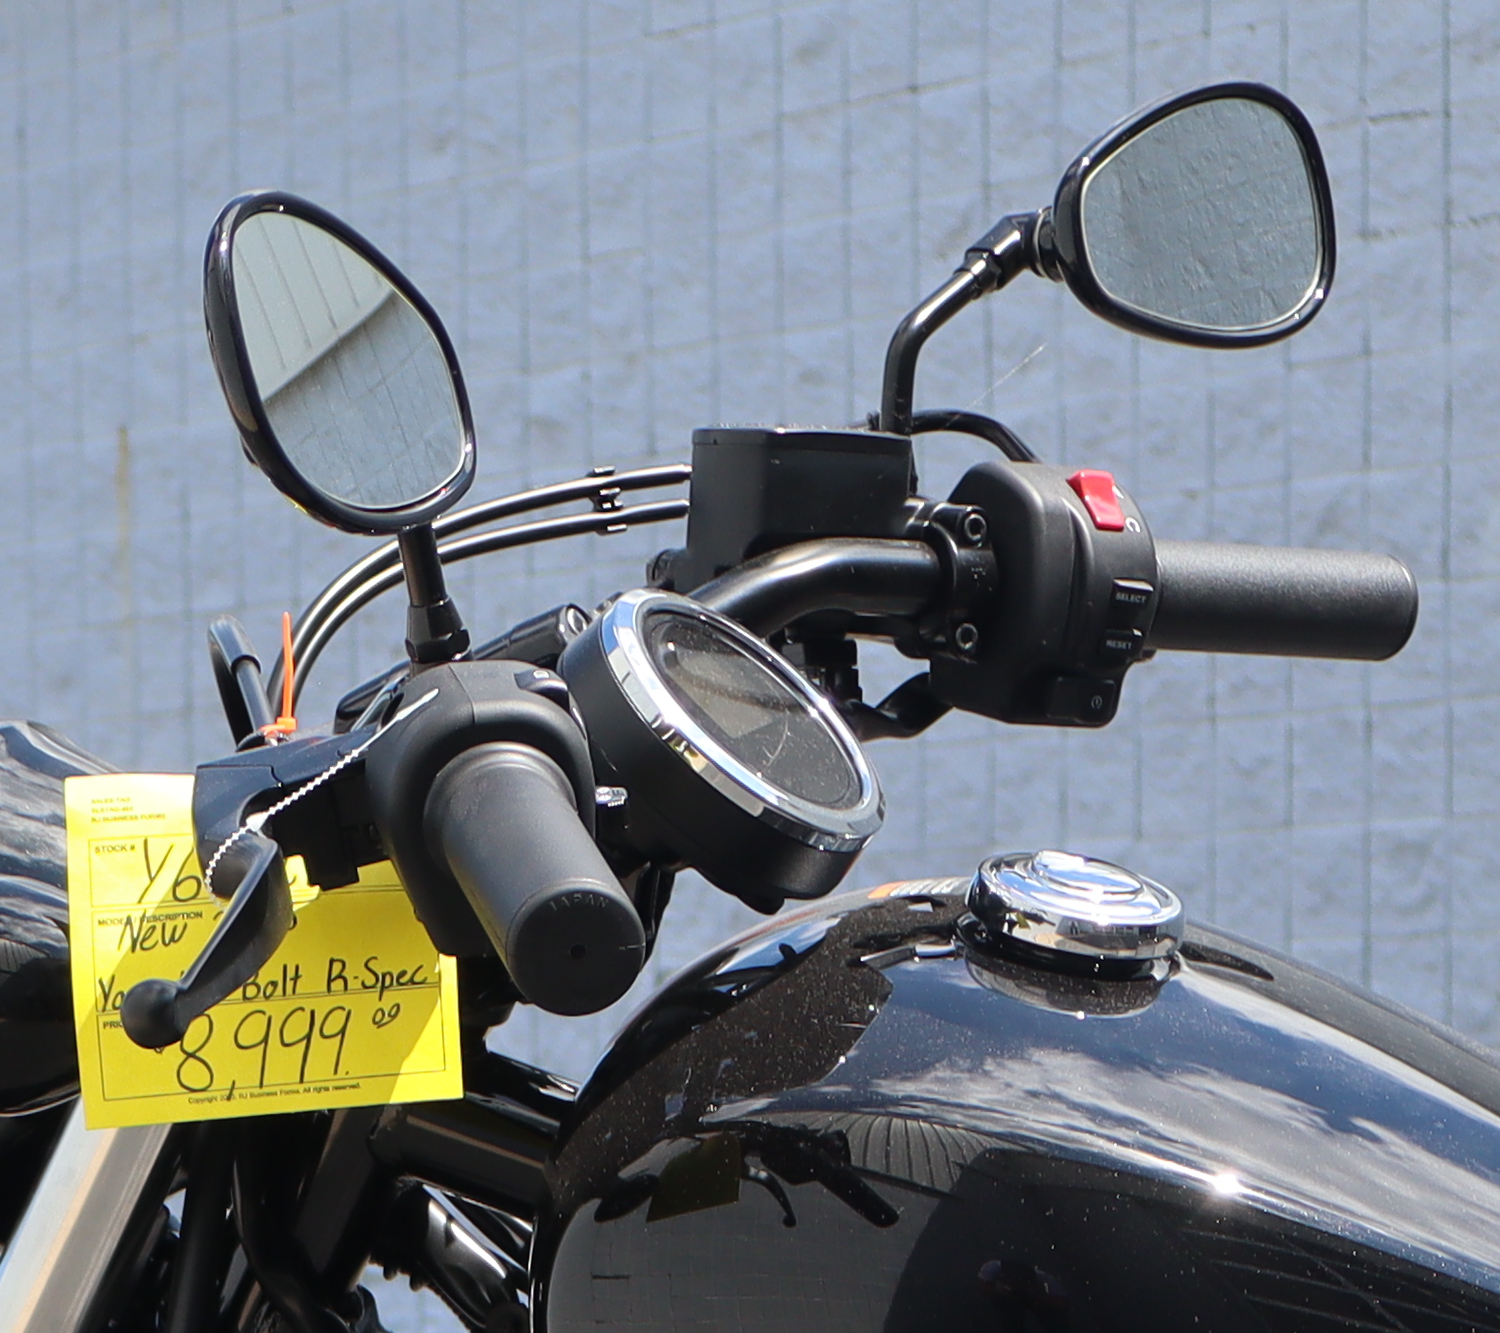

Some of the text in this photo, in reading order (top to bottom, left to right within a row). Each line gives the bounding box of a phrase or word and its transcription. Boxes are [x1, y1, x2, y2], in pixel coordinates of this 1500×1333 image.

[1115, 592, 1146, 604] SELECT
[1105, 639, 1132, 650] RESET
[95, 844, 127, 854] STOCK
[118, 909, 188, 954] New
[242, 963, 303, 1002] Bolt
[188, 1095, 218, 1104] Copyright
[249, 1090, 278, 1099] Business
[303, 1086, 312, 1094] All
[313, 1085, 330, 1094] rights
[332, 1082, 361, 1092] reserved.
